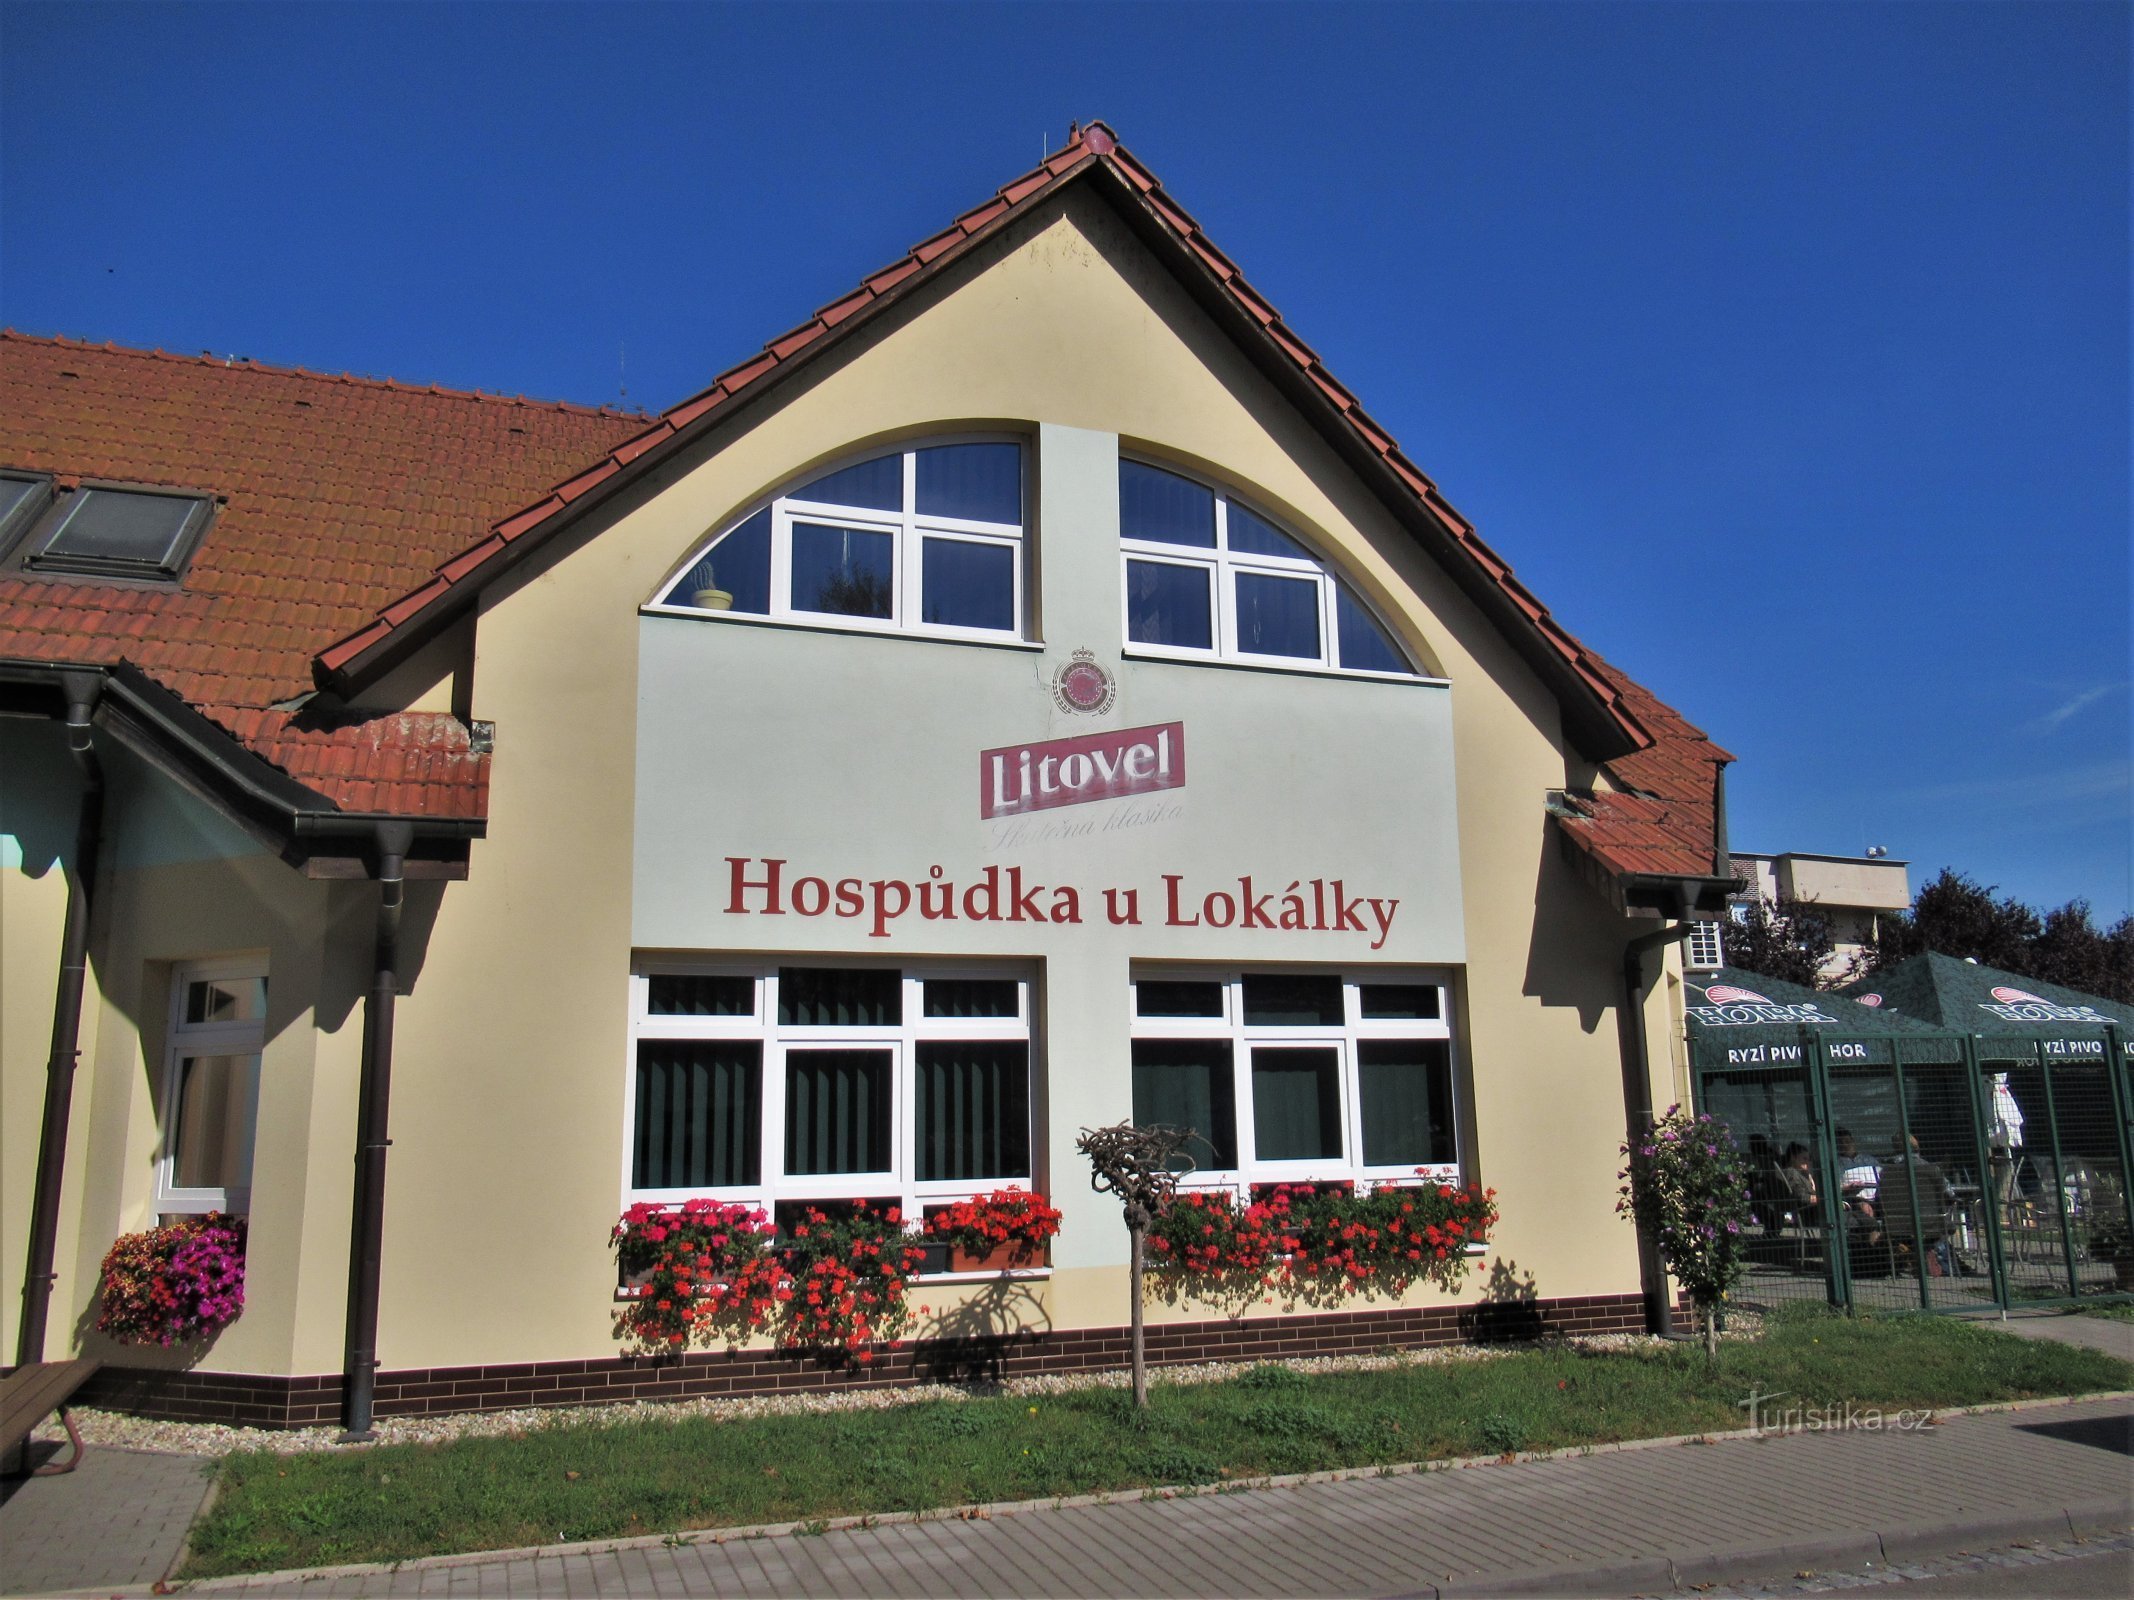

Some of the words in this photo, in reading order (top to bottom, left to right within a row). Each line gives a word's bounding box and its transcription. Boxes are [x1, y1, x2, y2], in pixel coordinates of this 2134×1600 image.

[992, 729, 1169, 807] Litovel
[1102, 800, 1185, 832] klasika
[723, 857, 1083, 936] Hospůdka
[1102, 889, 1142, 925] u
[1160, 873, 1400, 949] Lokálky
[1686, 1004, 1838, 1026] HOLBA
[1728, 1045, 1765, 1063] RYZÍ
[1829, 1044, 1866, 1058] HOR
[2069, 1041, 2102, 1054] PIVO
